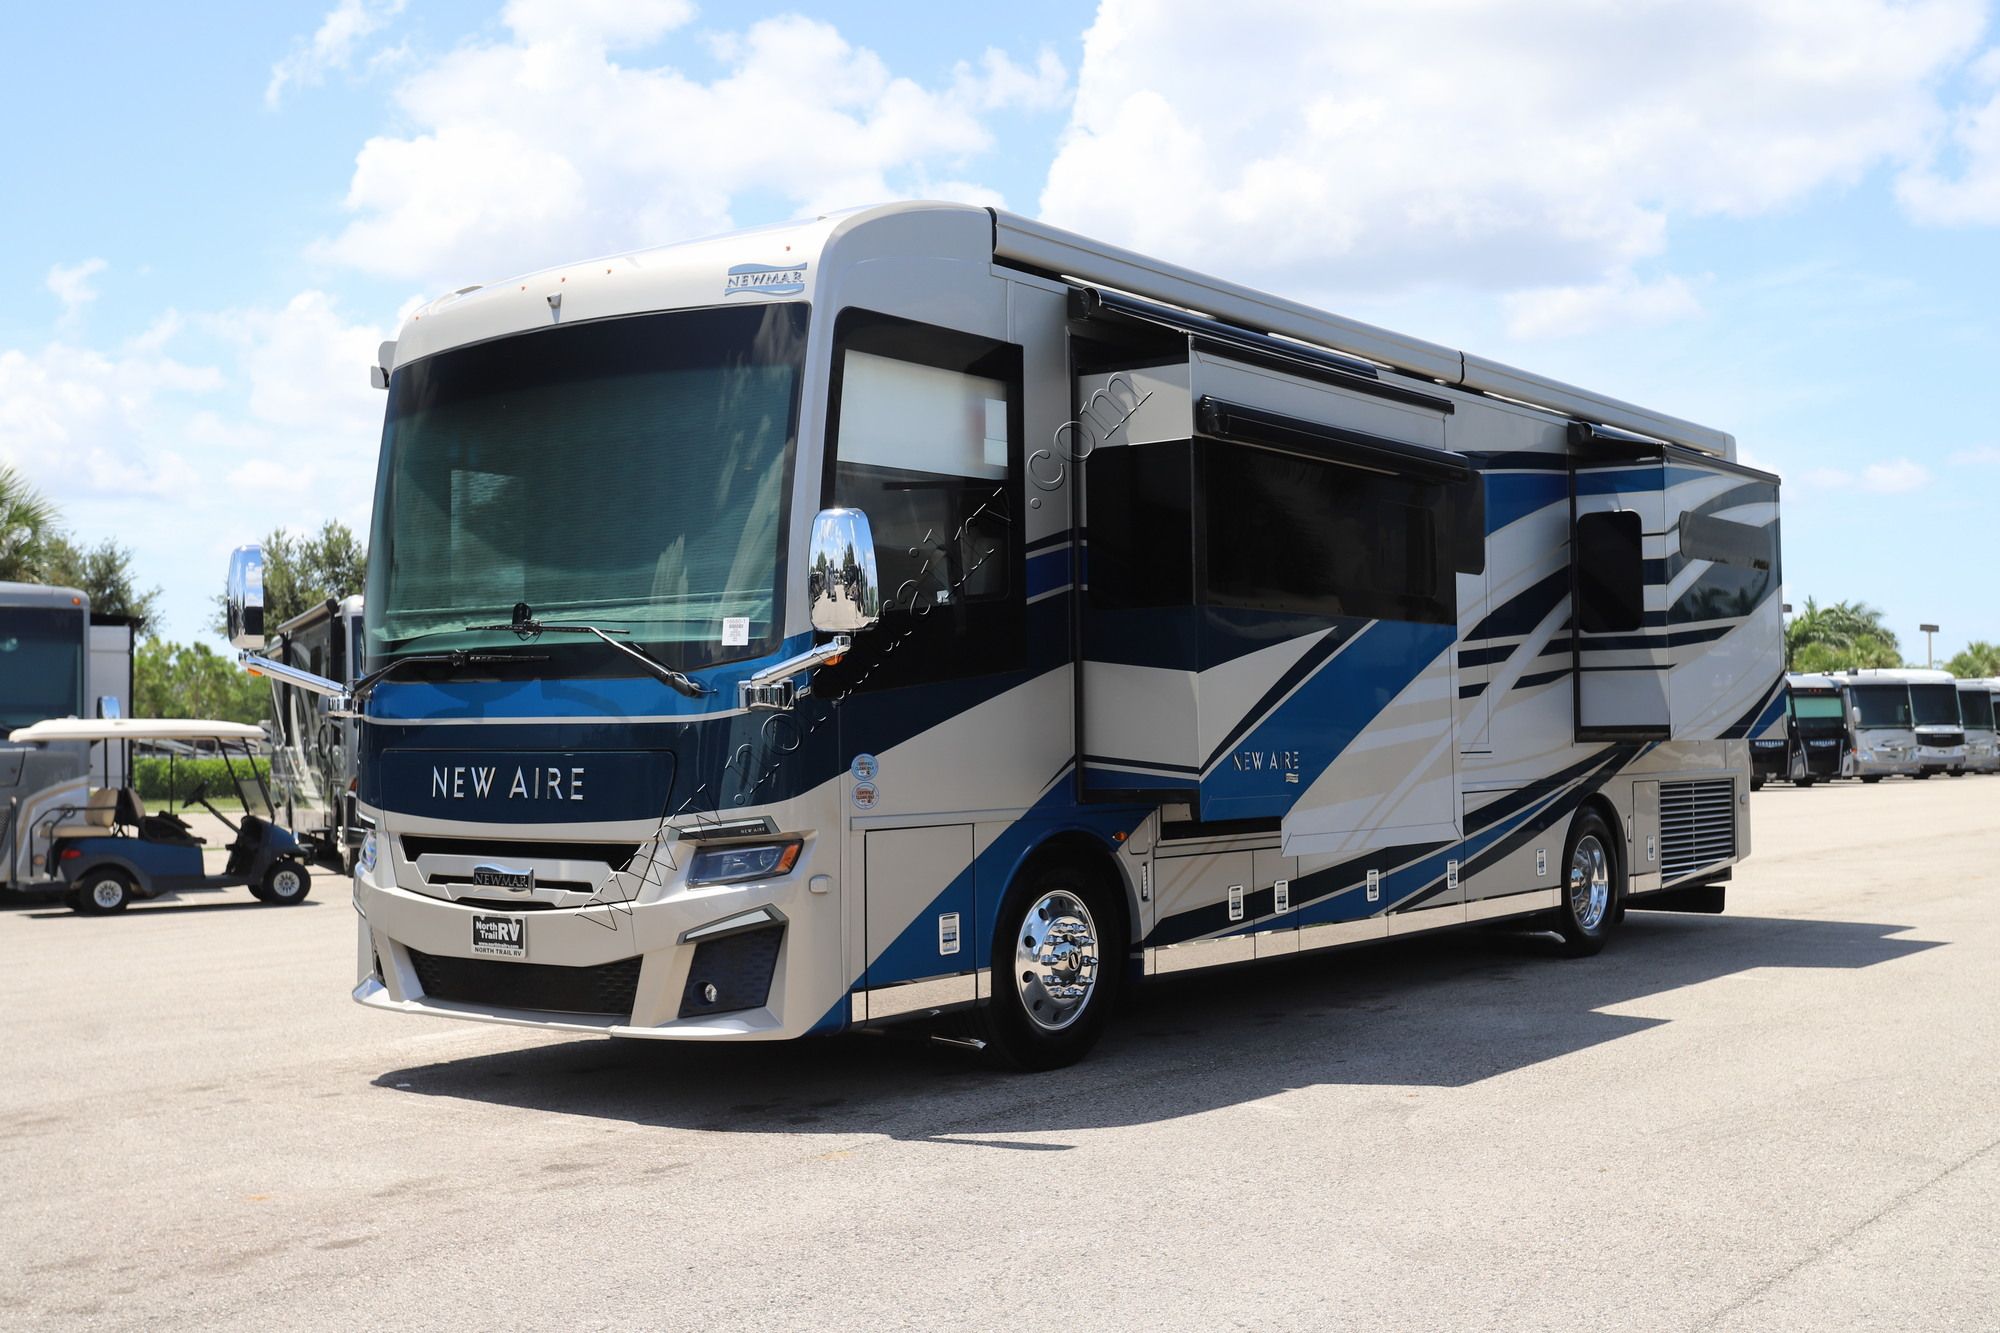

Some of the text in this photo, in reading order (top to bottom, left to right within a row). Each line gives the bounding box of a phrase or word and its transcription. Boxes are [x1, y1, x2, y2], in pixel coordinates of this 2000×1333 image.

[727, 271, 804, 288] NEWMAR
[1233, 751, 1299, 771] NEW AIRE
[432, 765, 585, 801] NEW AIRE
[474, 873, 528, 888] NEWMAR
[476, 921, 497, 930] North
[498, 922, 520, 941] RV
[480, 930, 497, 940] Trail
